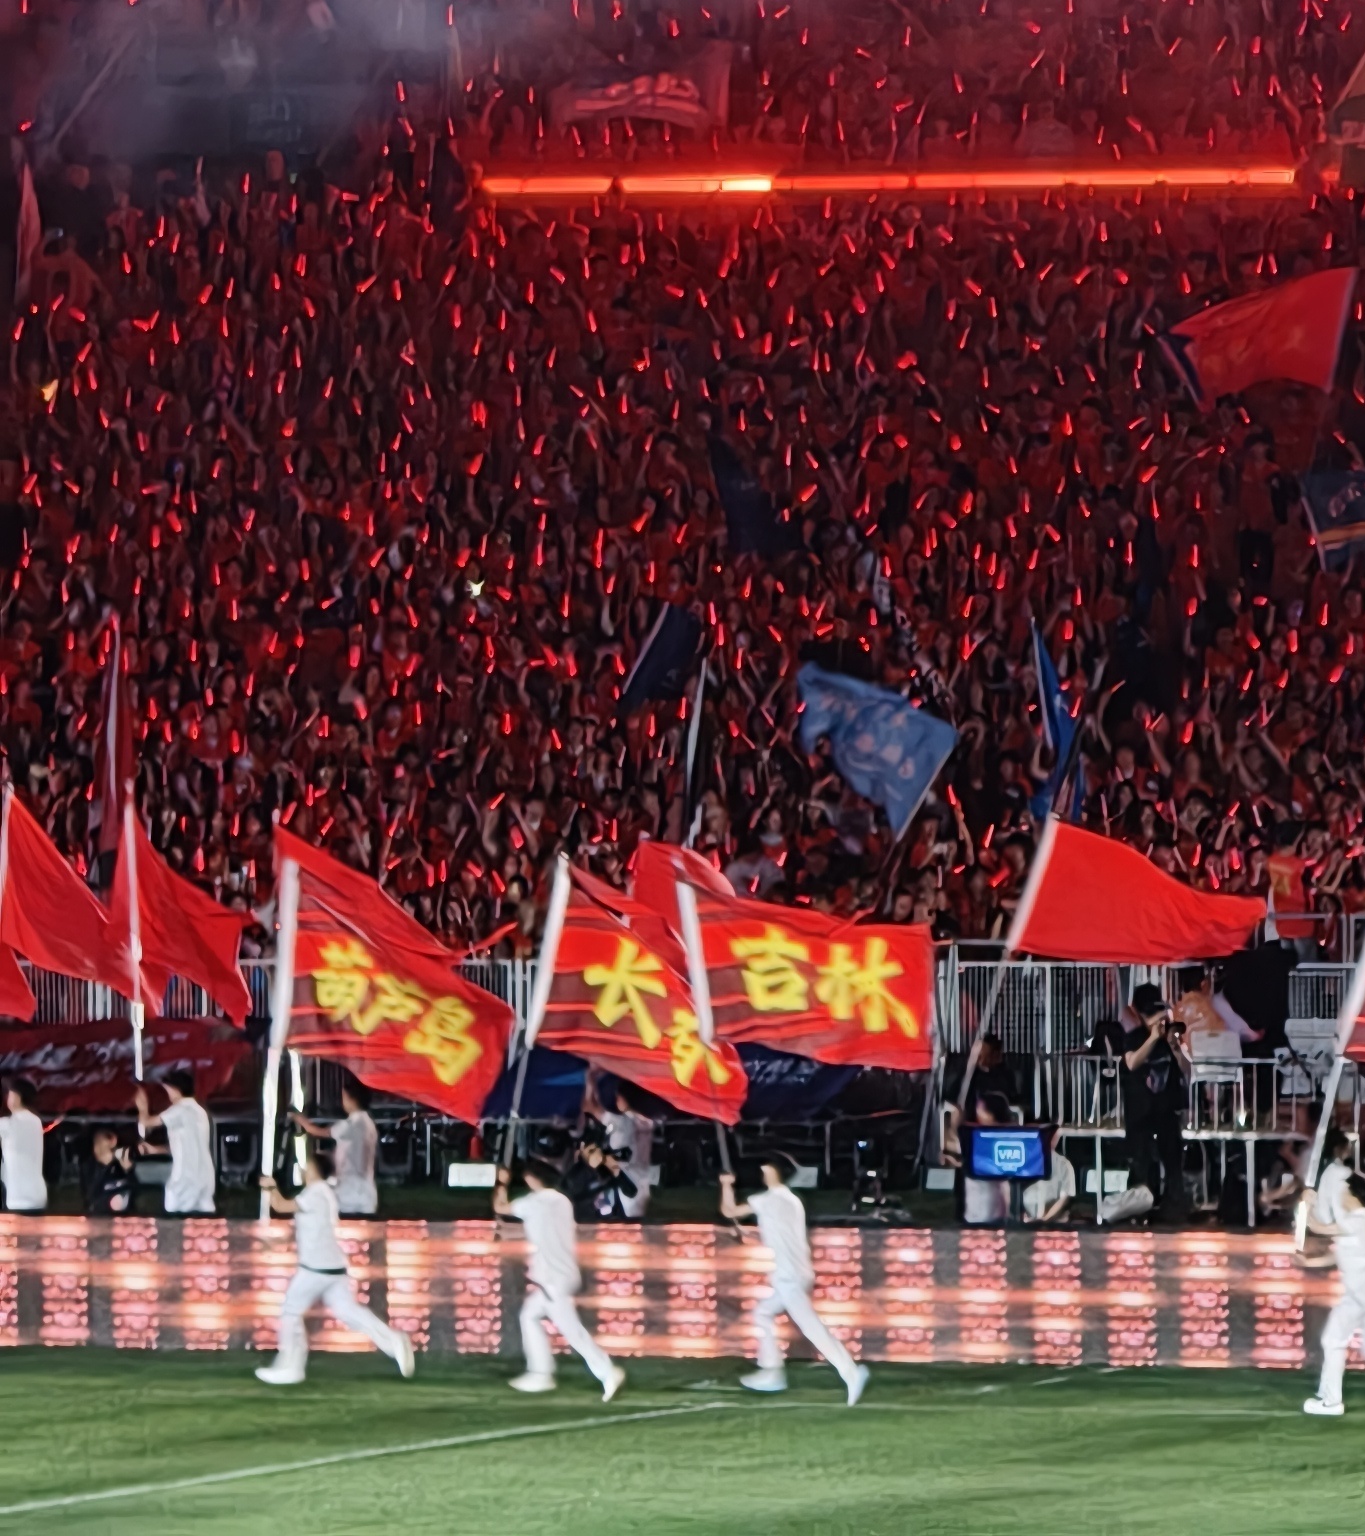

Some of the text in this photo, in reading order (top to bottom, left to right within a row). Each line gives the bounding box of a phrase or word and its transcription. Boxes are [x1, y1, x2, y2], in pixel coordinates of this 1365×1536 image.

[312, 938, 481, 1086] 葫芦岛
[730, 924, 918, 1038] 吉林
